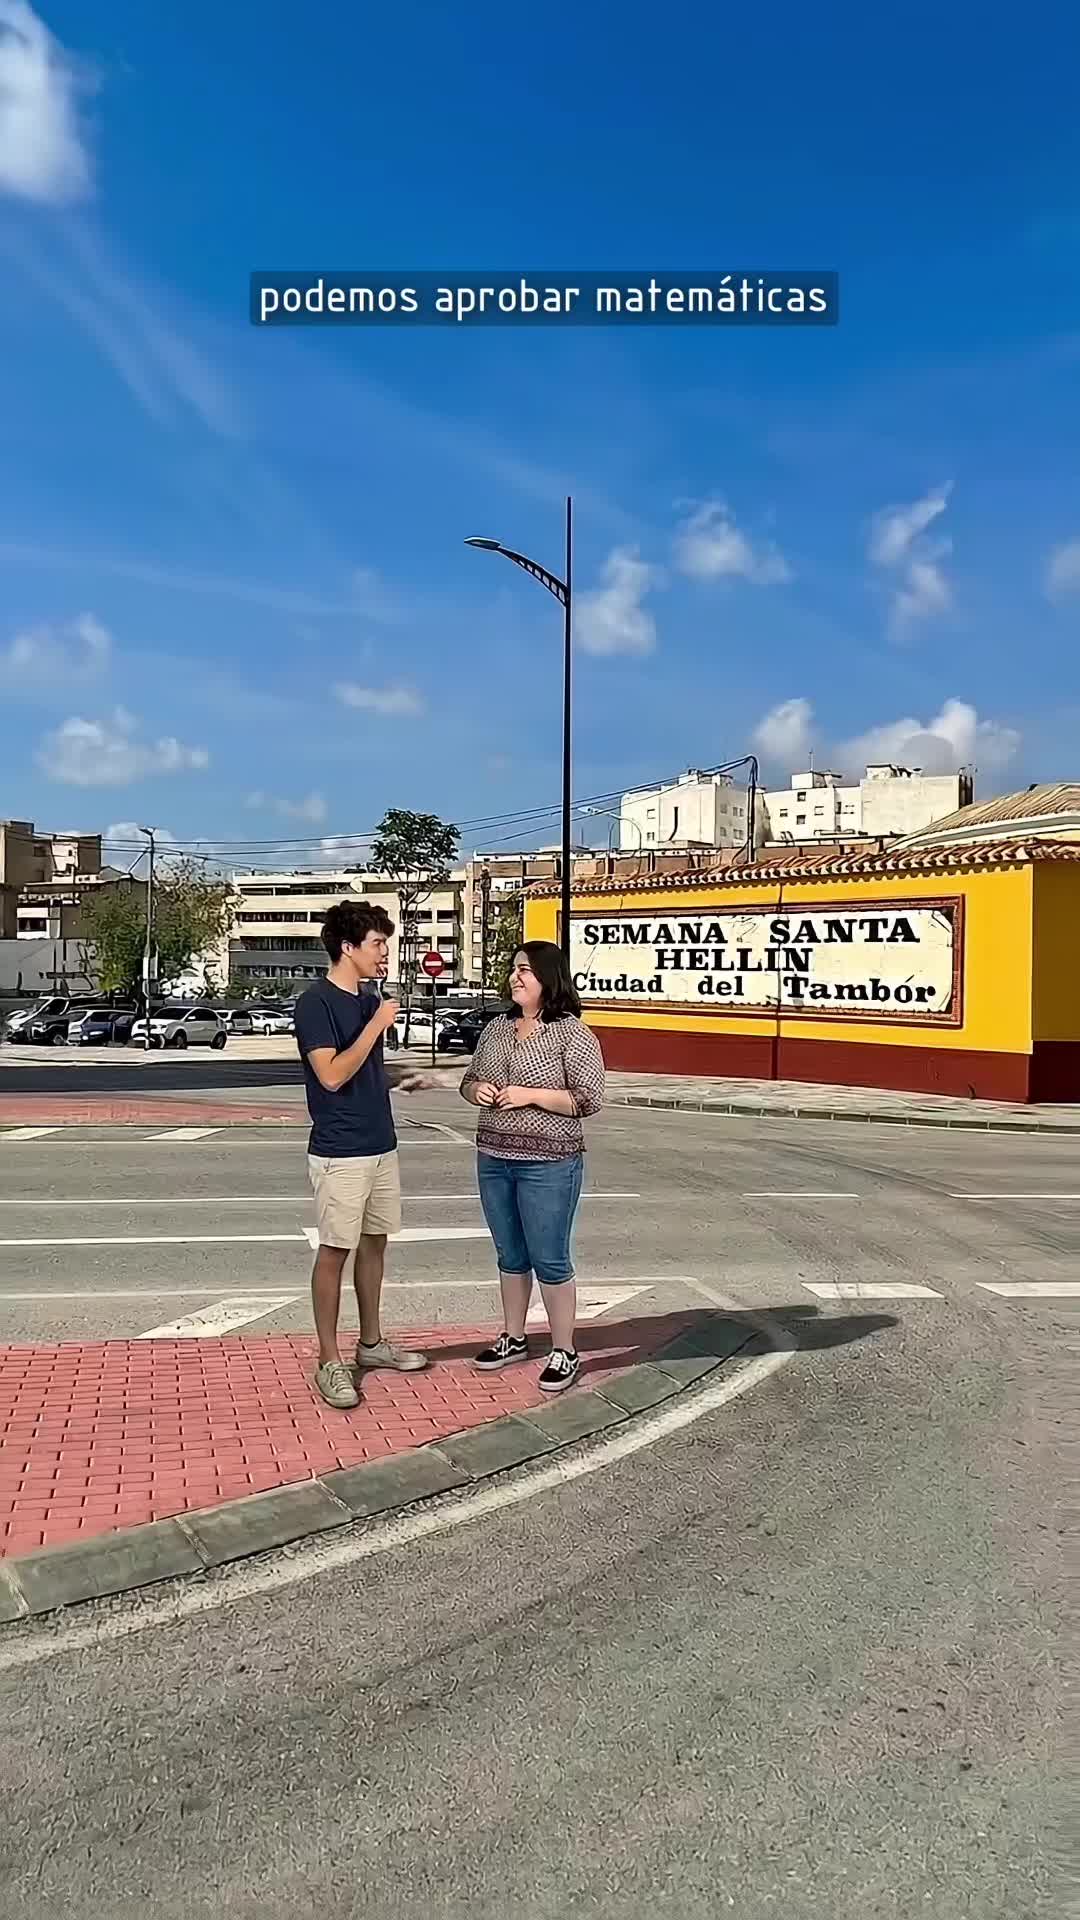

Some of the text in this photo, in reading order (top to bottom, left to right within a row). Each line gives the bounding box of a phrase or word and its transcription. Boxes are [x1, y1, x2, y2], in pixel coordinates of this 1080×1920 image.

[584, 918, 920, 945] SEMANA SANTA
[655, 948, 813, 972] HELLIN
[573, 972, 935, 1003] Ciudad del Tambór
